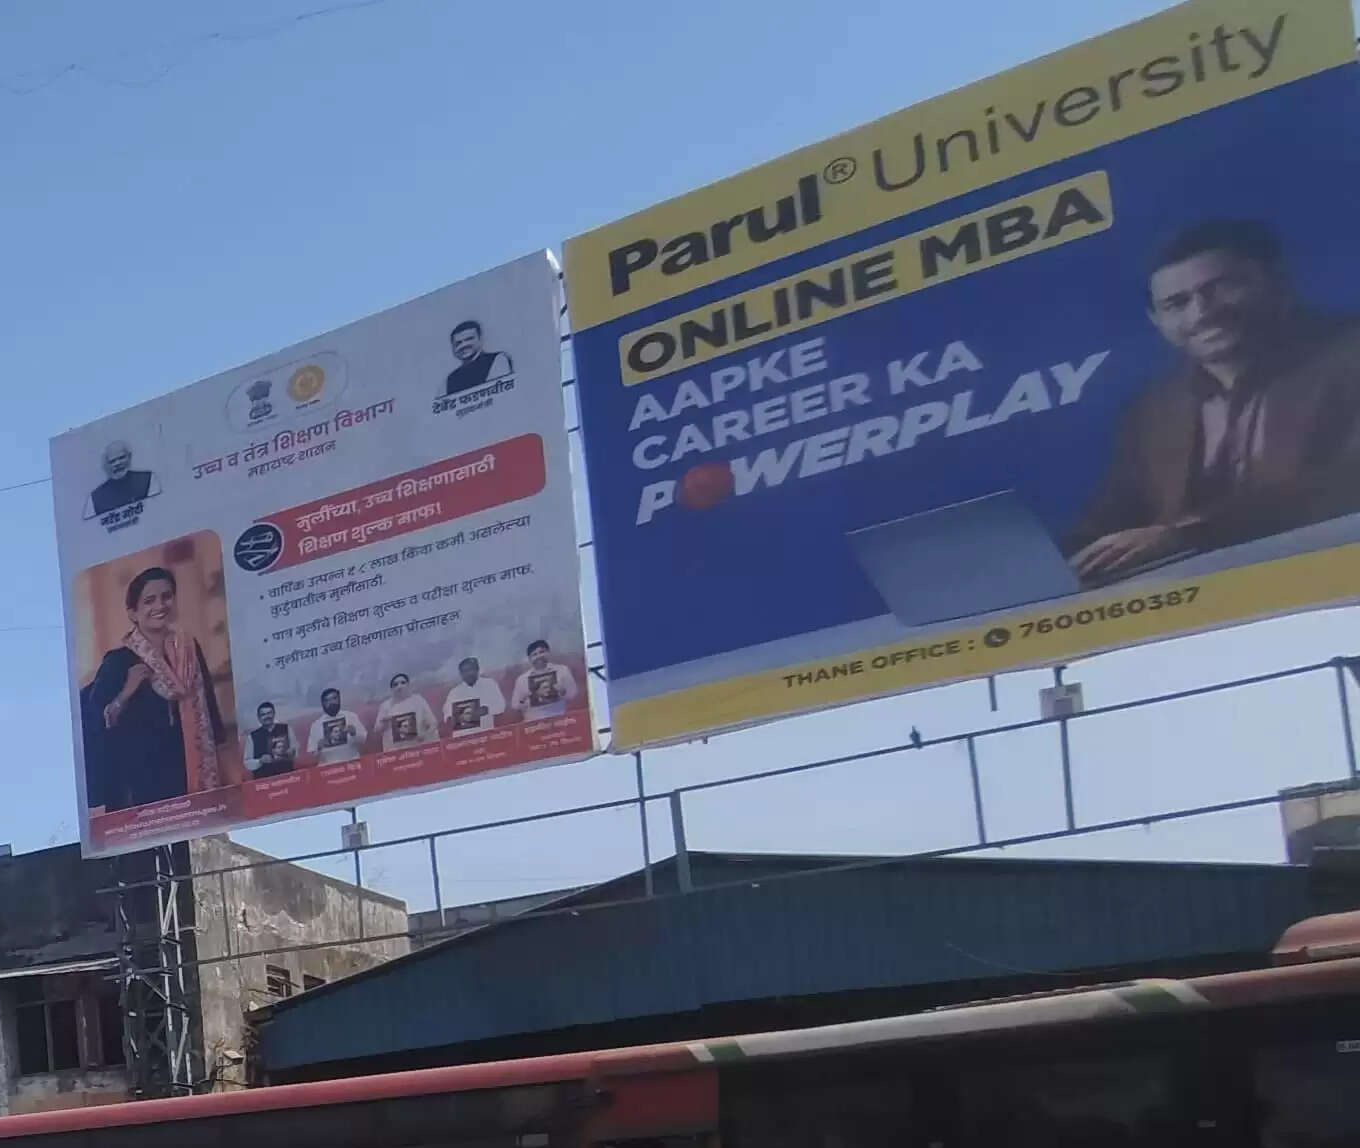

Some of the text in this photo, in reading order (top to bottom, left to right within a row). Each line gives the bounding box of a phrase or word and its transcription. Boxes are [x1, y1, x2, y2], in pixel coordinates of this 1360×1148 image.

[873, 14, 1288, 192] University
[627, 187, 1104, 374] ONLINE MBA
[627, 338, 827, 430] AAPKE
[632, 341, 984, 471] CAREER KA
[191, 397, 396, 480] उच्च व तंत्र शिक्षण विभाग
[364, 488, 394, 509] उच्च
[396, 453, 497, 502] शिक्षणासाठी
[297, 528, 348, 558] शिक्षण
[351, 515, 394, 543] शुल्क
[333, 606, 370, 628] शिक्षण
[372, 596, 409, 619] शुल्क
[409, 594, 420, 607] व
[421, 580, 458, 602] परीक्षा
[461, 570, 497, 594] शुल्क
[783, 661, 864, 689] THANE
[871, 639, 962, 672] OFFICE
[1019, 587, 1200, 639] 7600160387
